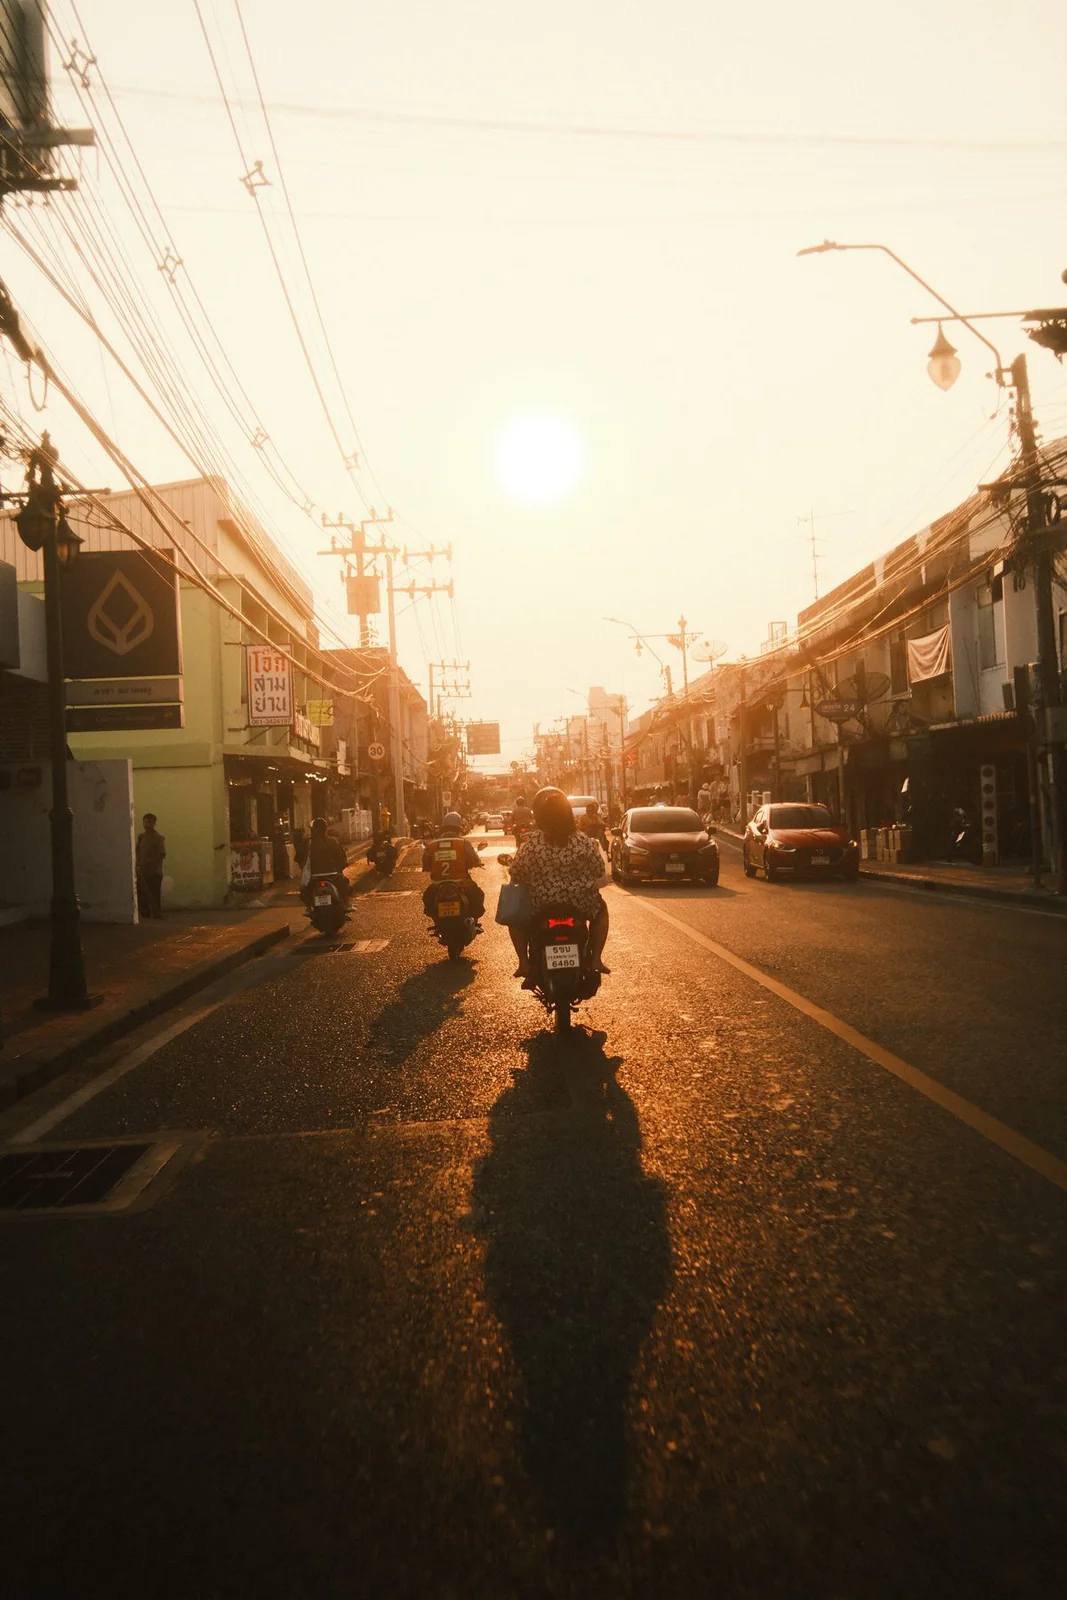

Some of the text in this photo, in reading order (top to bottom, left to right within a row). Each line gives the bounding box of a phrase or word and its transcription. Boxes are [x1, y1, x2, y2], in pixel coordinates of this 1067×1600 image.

[255, 692, 286, 712] ย่าน
[843, 703, 855, 712] 24
[370, 746, 383, 756] 30
[441, 862, 450, 876] 2
[552, 959, 575, 968] 6480
